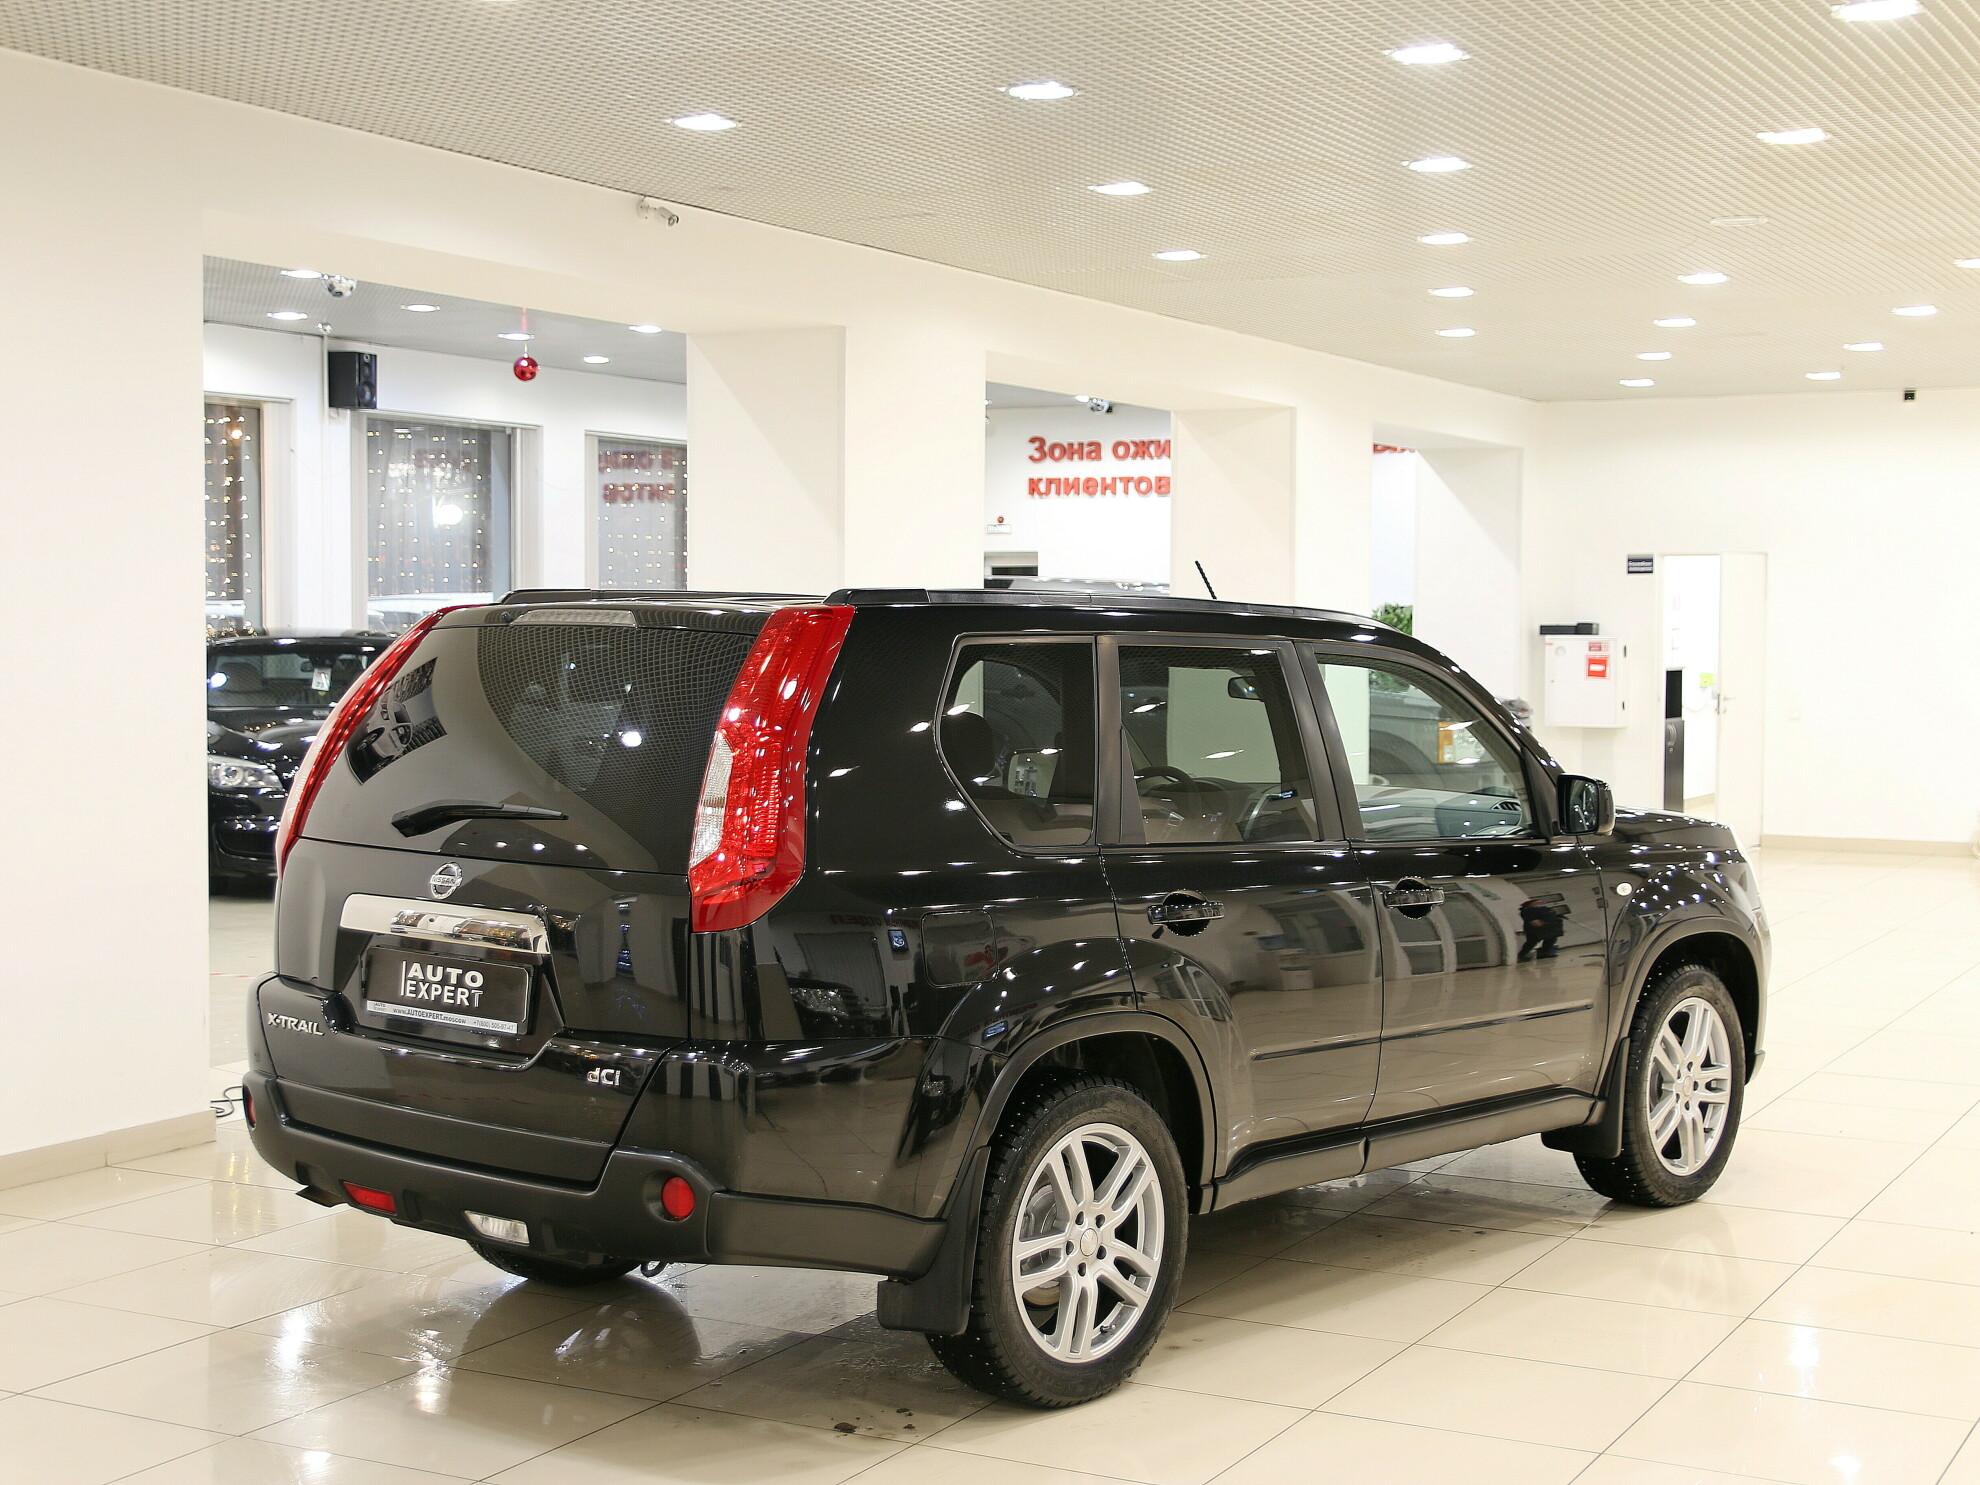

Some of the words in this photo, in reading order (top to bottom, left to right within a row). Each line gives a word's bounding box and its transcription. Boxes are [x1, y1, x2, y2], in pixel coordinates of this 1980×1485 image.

[1028, 436, 1102, 463] Зона
[1028, 475, 1171, 497] клиентов
[431, 875, 461, 887] NISSAN
[407, 962, 484, 988] AUTO
[405, 980, 484, 1008] EXPERT
[267, 1012, 324, 1036] X-TRAIL
